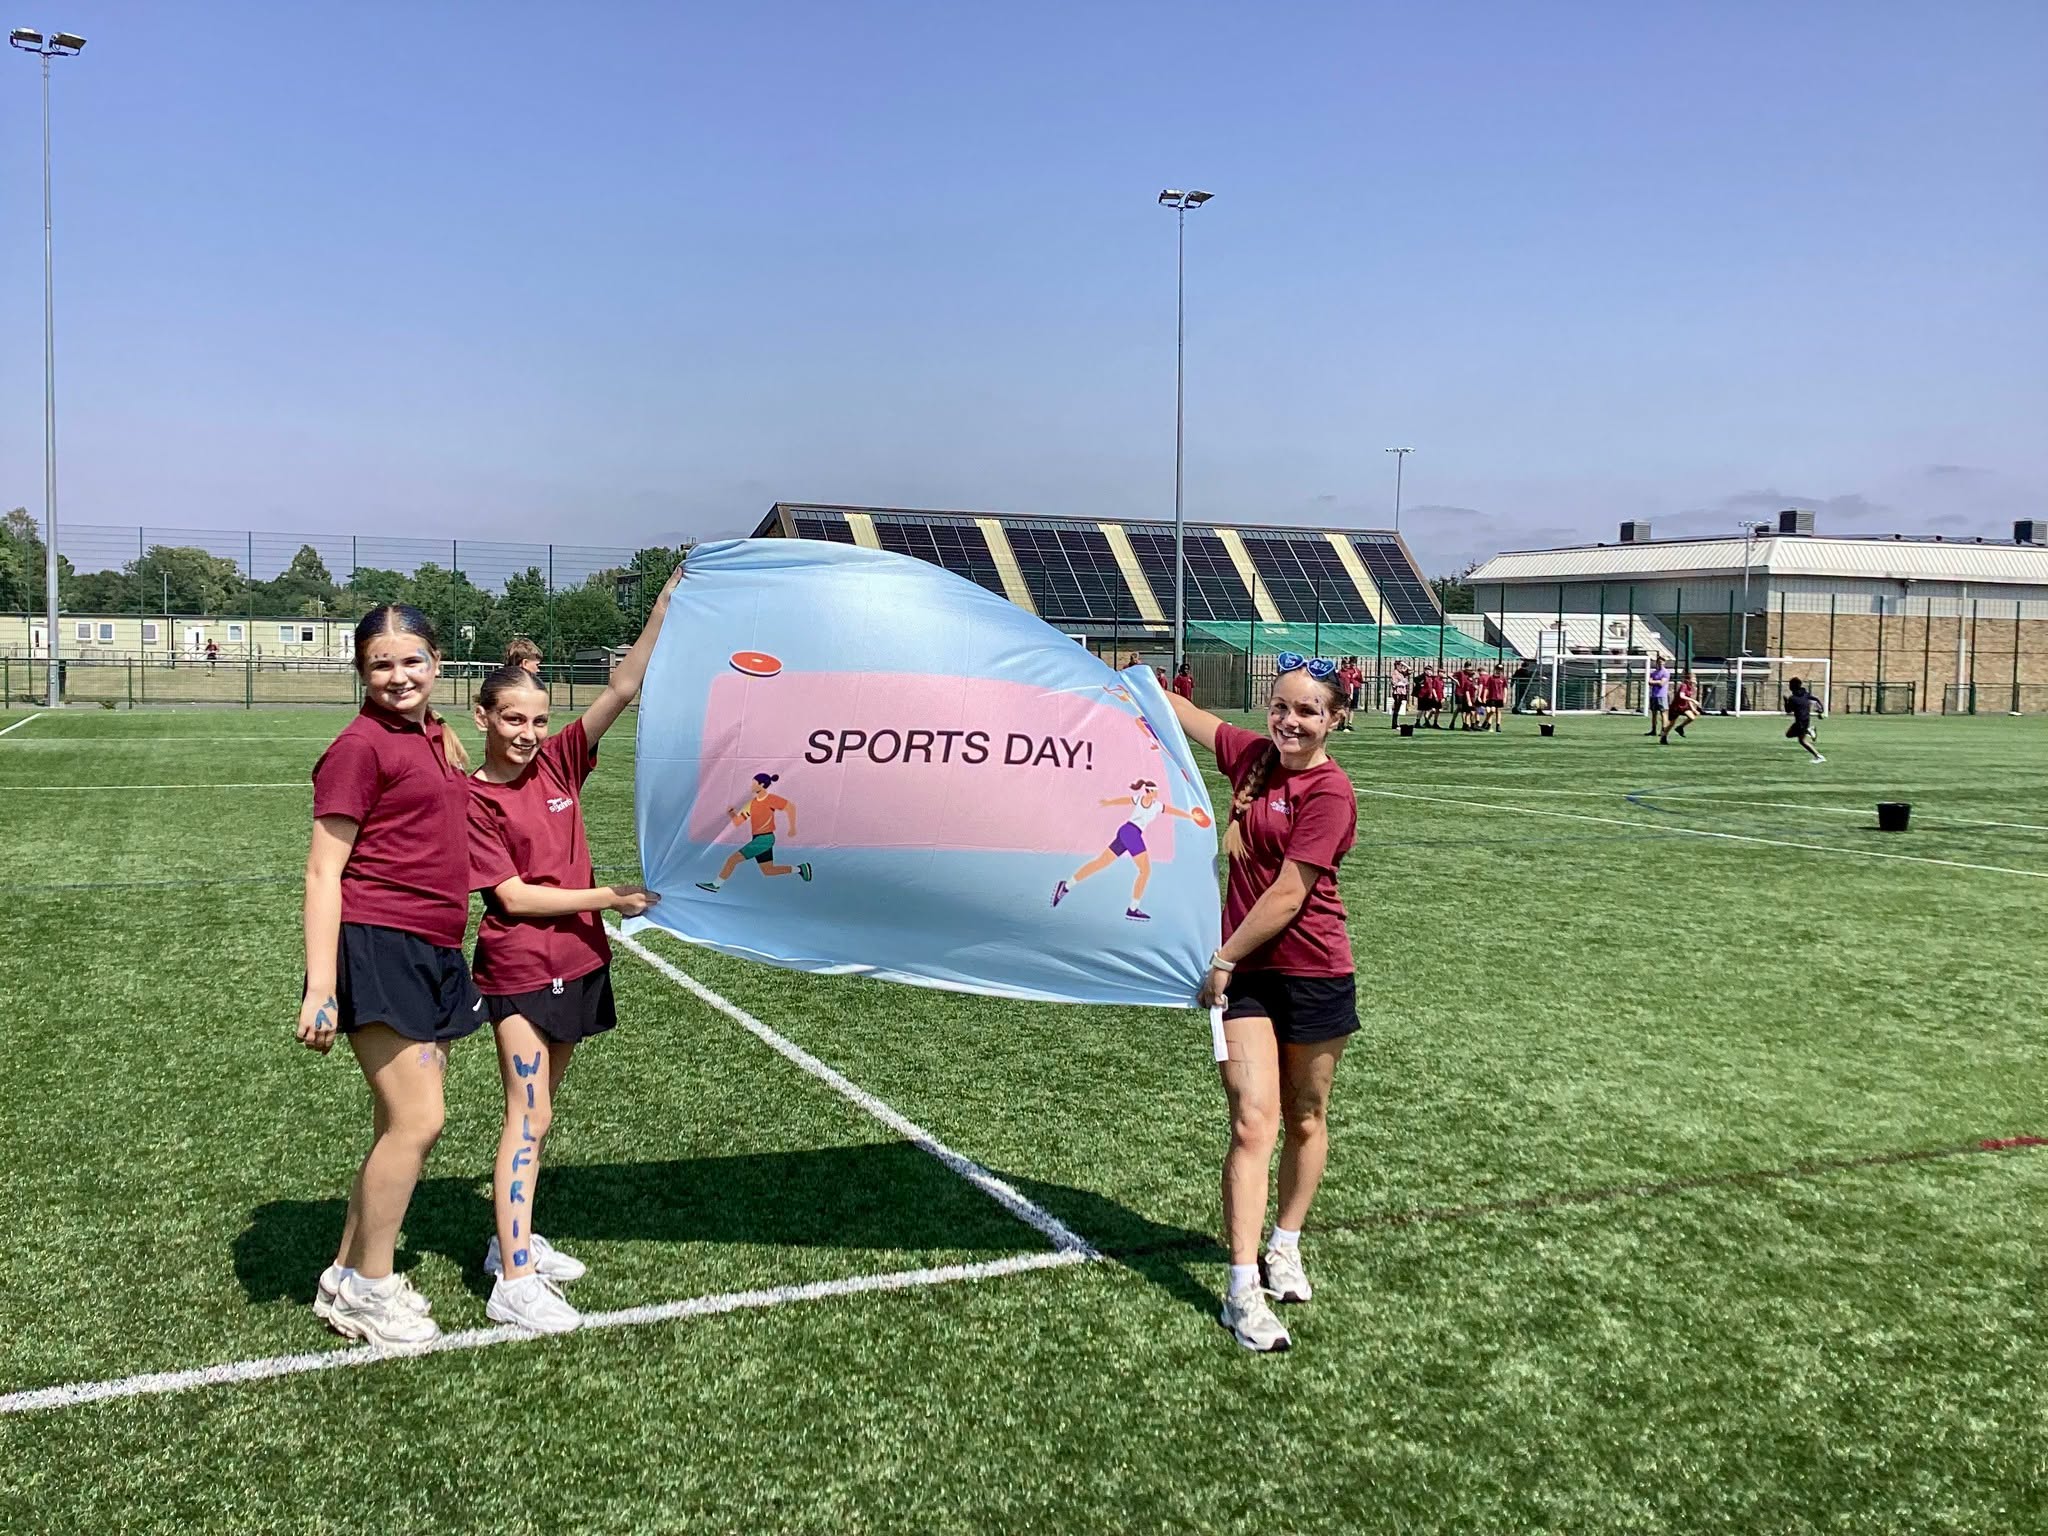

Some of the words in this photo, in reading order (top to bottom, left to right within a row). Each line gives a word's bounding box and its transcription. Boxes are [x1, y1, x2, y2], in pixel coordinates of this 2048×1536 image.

[804, 729, 990, 764] SPORTS
[1003, 733, 1093, 770] DAY!
[510, 1051, 541, 1267] WILFRID
